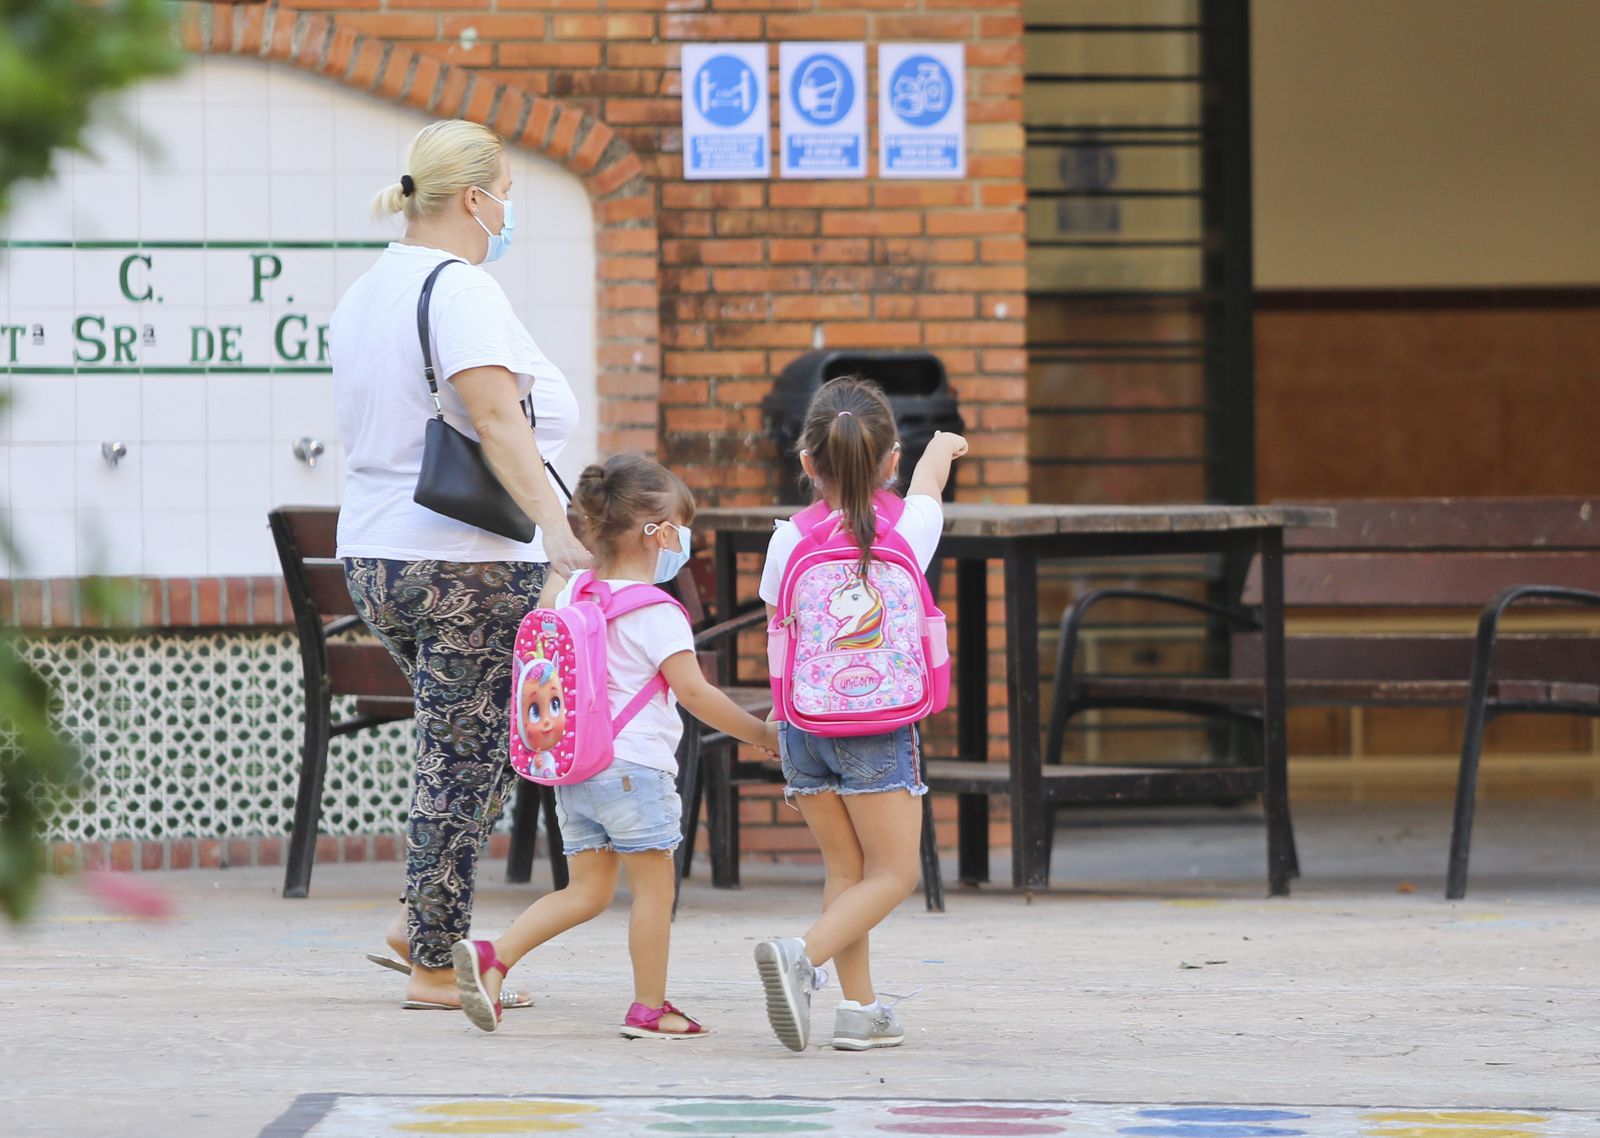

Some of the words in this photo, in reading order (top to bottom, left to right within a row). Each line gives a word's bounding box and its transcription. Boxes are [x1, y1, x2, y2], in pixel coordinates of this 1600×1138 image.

[118, 253, 163, 303] C.
[249, 253, 294, 303] P.
[190, 325, 243, 362] DE
